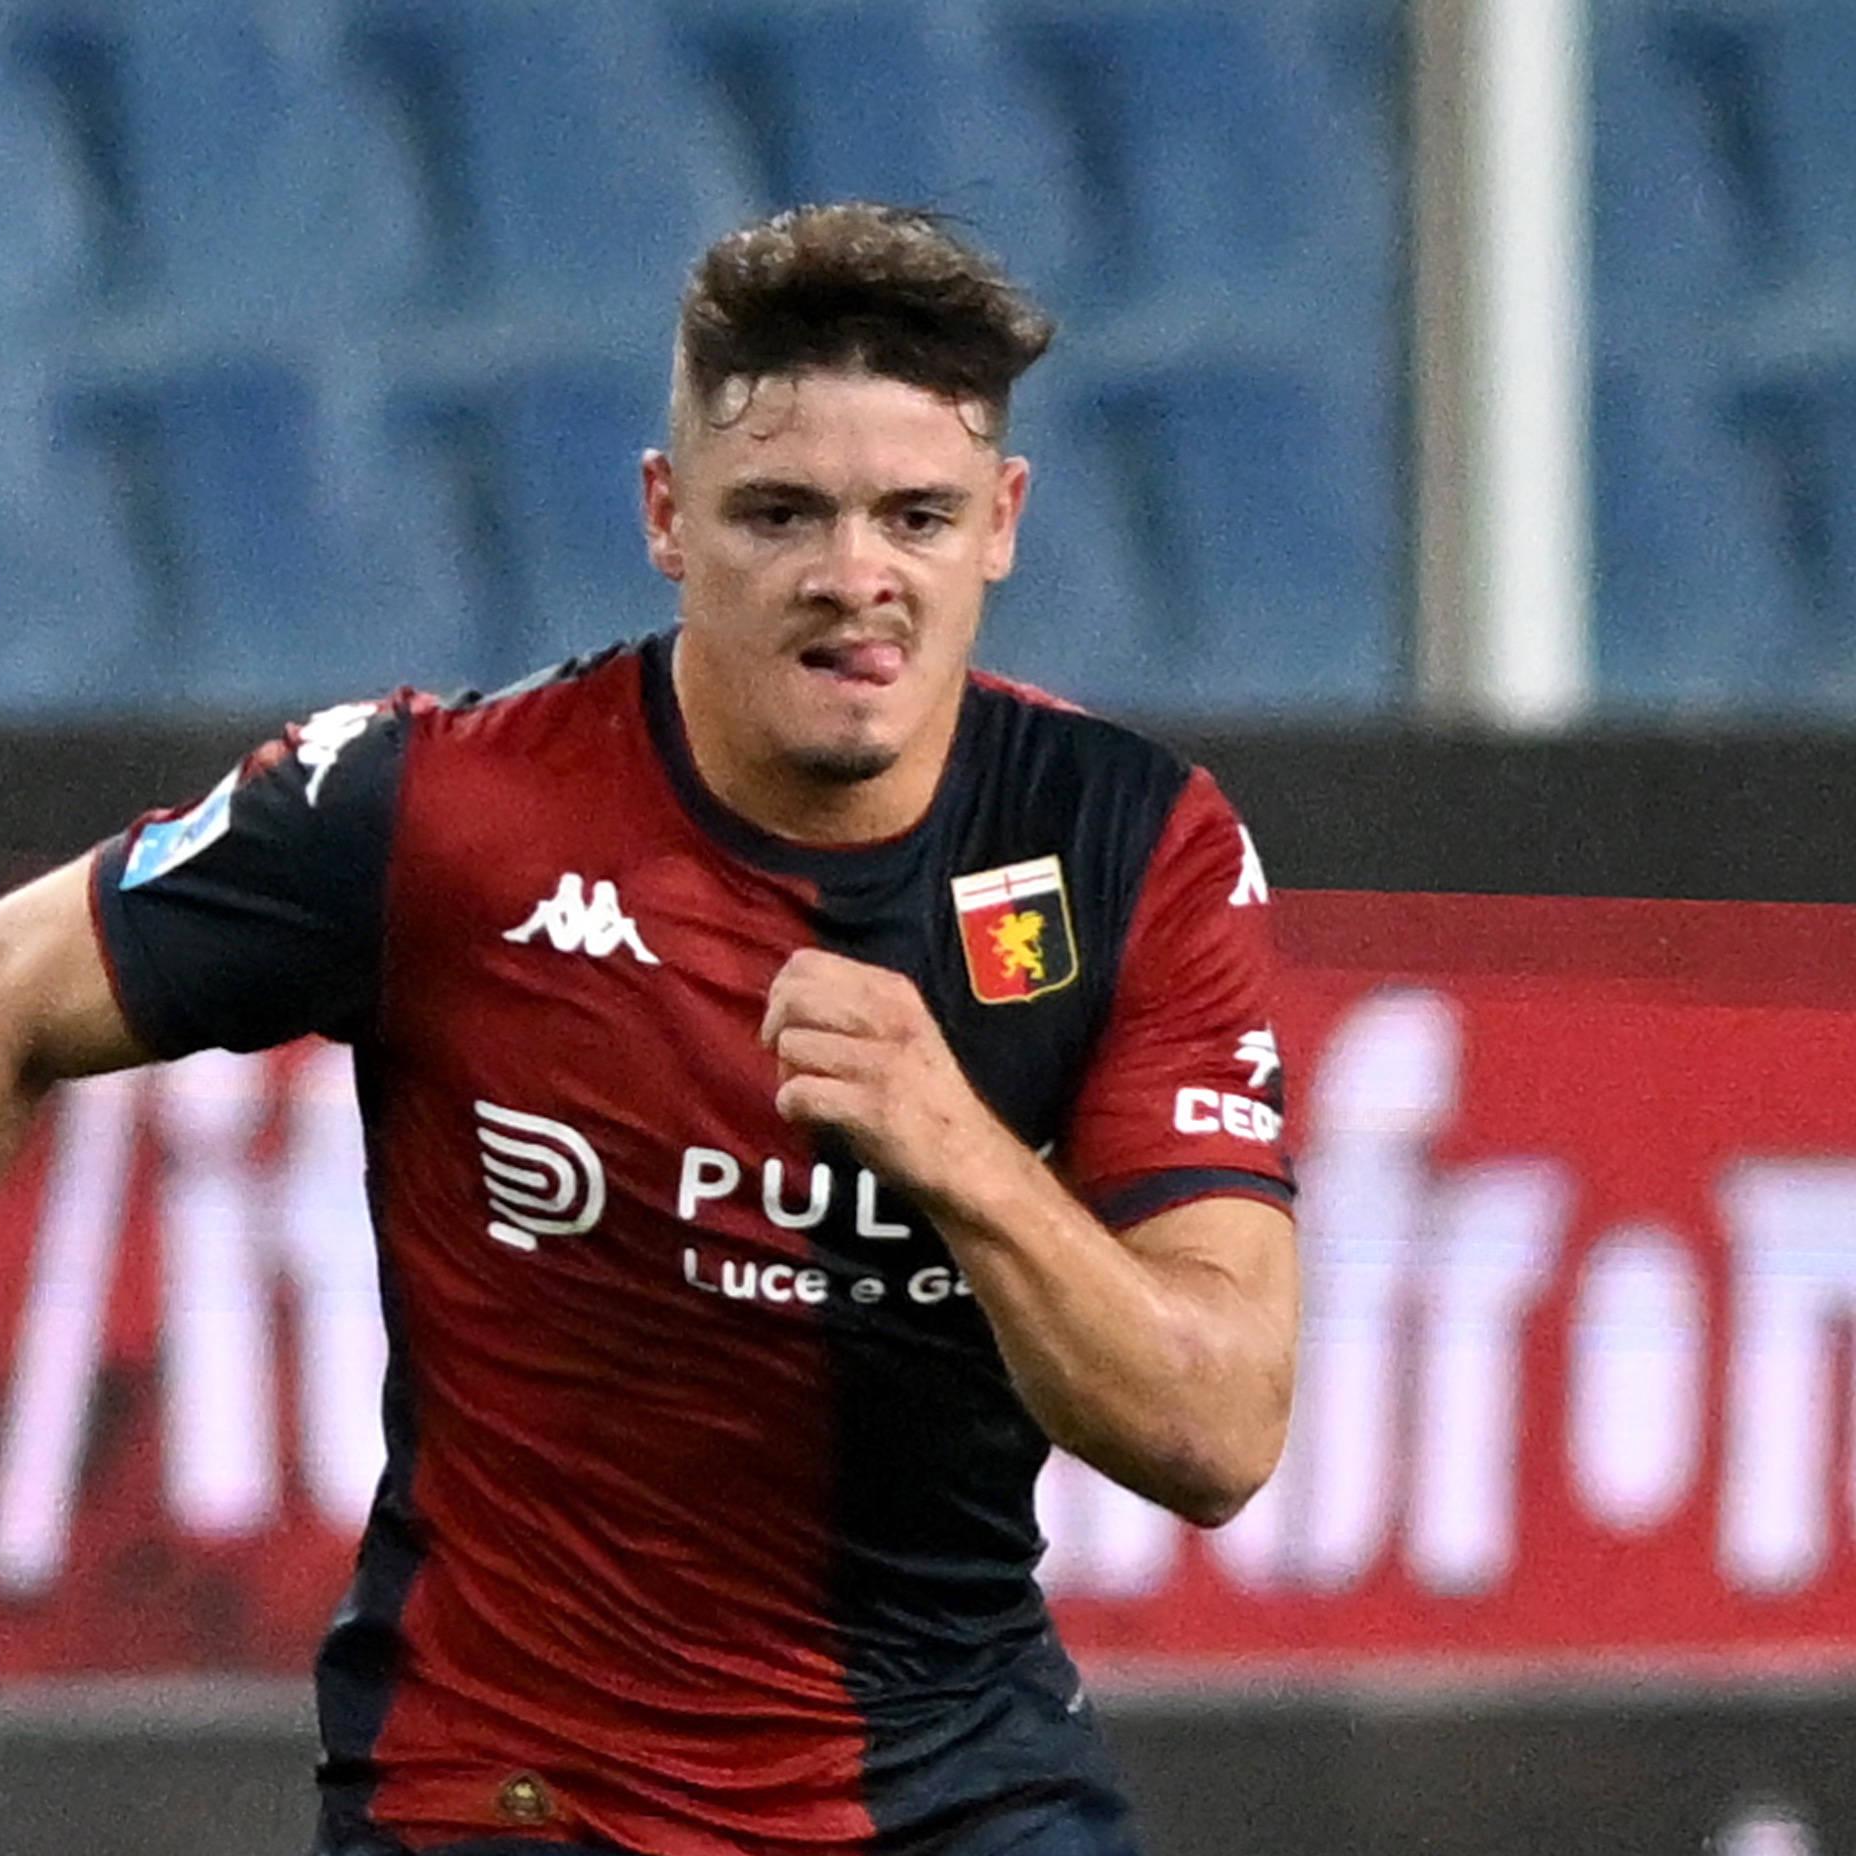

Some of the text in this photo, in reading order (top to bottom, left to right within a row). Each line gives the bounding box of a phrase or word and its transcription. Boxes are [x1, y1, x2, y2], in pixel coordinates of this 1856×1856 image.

[677, 1146, 912, 1240] PUL
[684, 1248, 829, 1303] Luce
[850, 1277, 886, 1304] e
